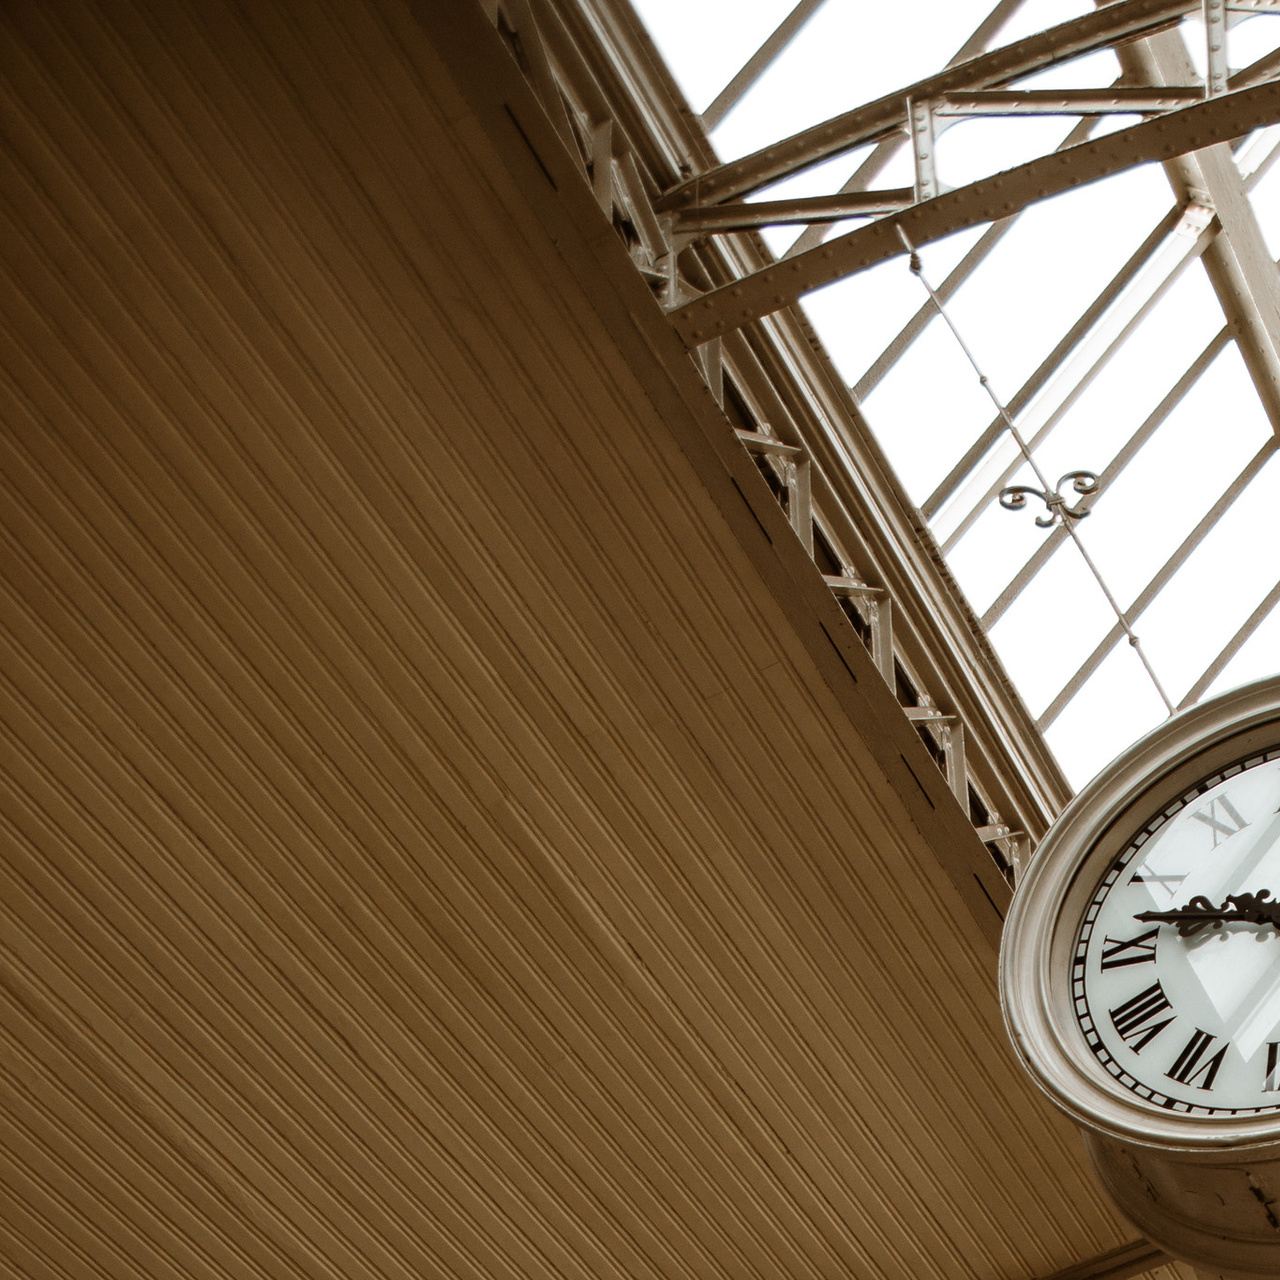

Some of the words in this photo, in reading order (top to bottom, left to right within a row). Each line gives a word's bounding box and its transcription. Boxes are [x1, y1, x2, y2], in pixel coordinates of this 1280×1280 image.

[1189, 793, 1252, 851] XI
[1128, 862, 1191, 899] X
[1108, 978, 1177, 1056] VIII
[1164, 1028, 1227, 1091] VII
